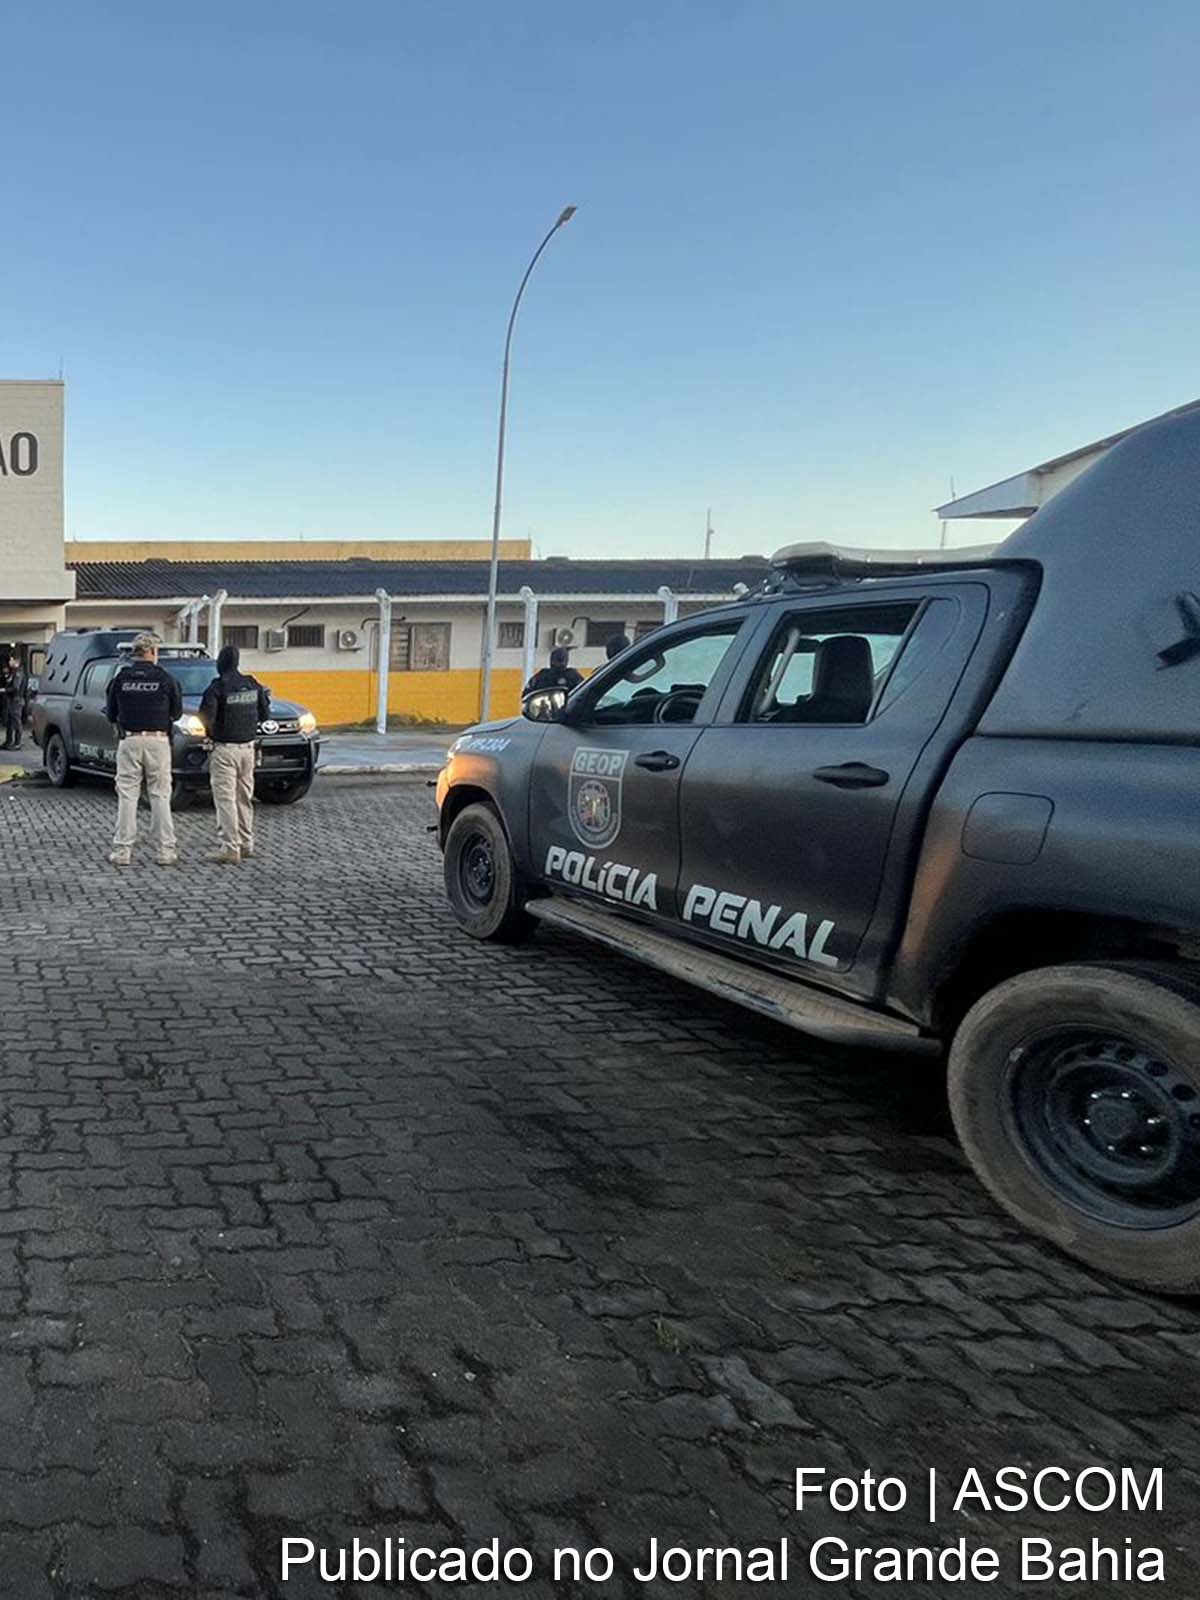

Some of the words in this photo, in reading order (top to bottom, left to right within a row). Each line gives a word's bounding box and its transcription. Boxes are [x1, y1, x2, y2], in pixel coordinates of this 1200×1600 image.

[122, 682, 160, 691] GAECO
[575, 752, 622, 775] GEOP
[545, 846, 658, 911] POLÍCIA
[682, 885, 839, 967] PENAL
